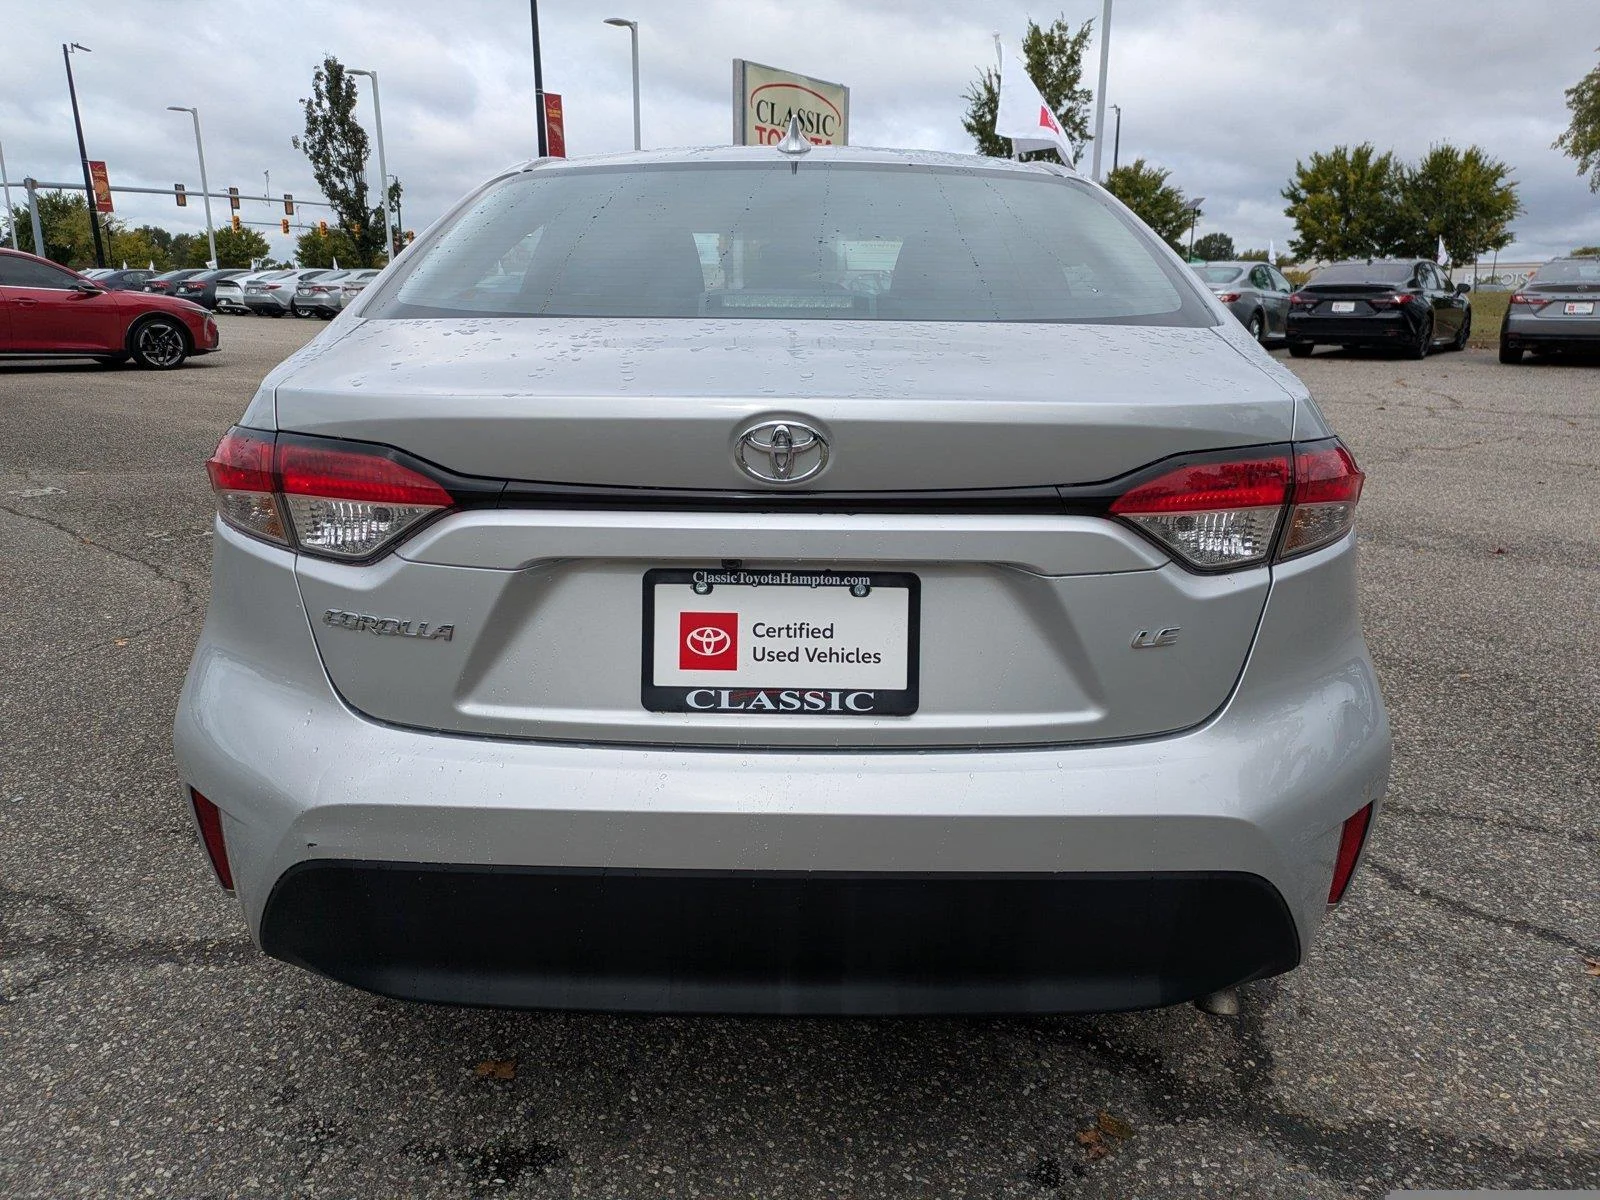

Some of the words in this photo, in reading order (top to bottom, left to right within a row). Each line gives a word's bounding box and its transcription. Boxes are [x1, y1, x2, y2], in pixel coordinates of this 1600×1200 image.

[756, 99, 835, 137] CLASSIC
[692, 571, 871, 588] ClassicToyotaHampton.com
[322, 608, 455, 642] COROLLA
[752, 622, 834, 639] Certified
[1130, 627, 1181, 649] LE
[752, 646, 800, 663] Used
[804, 647, 882, 664] Vehicles
[685, 689, 875, 711] CLASSIC
